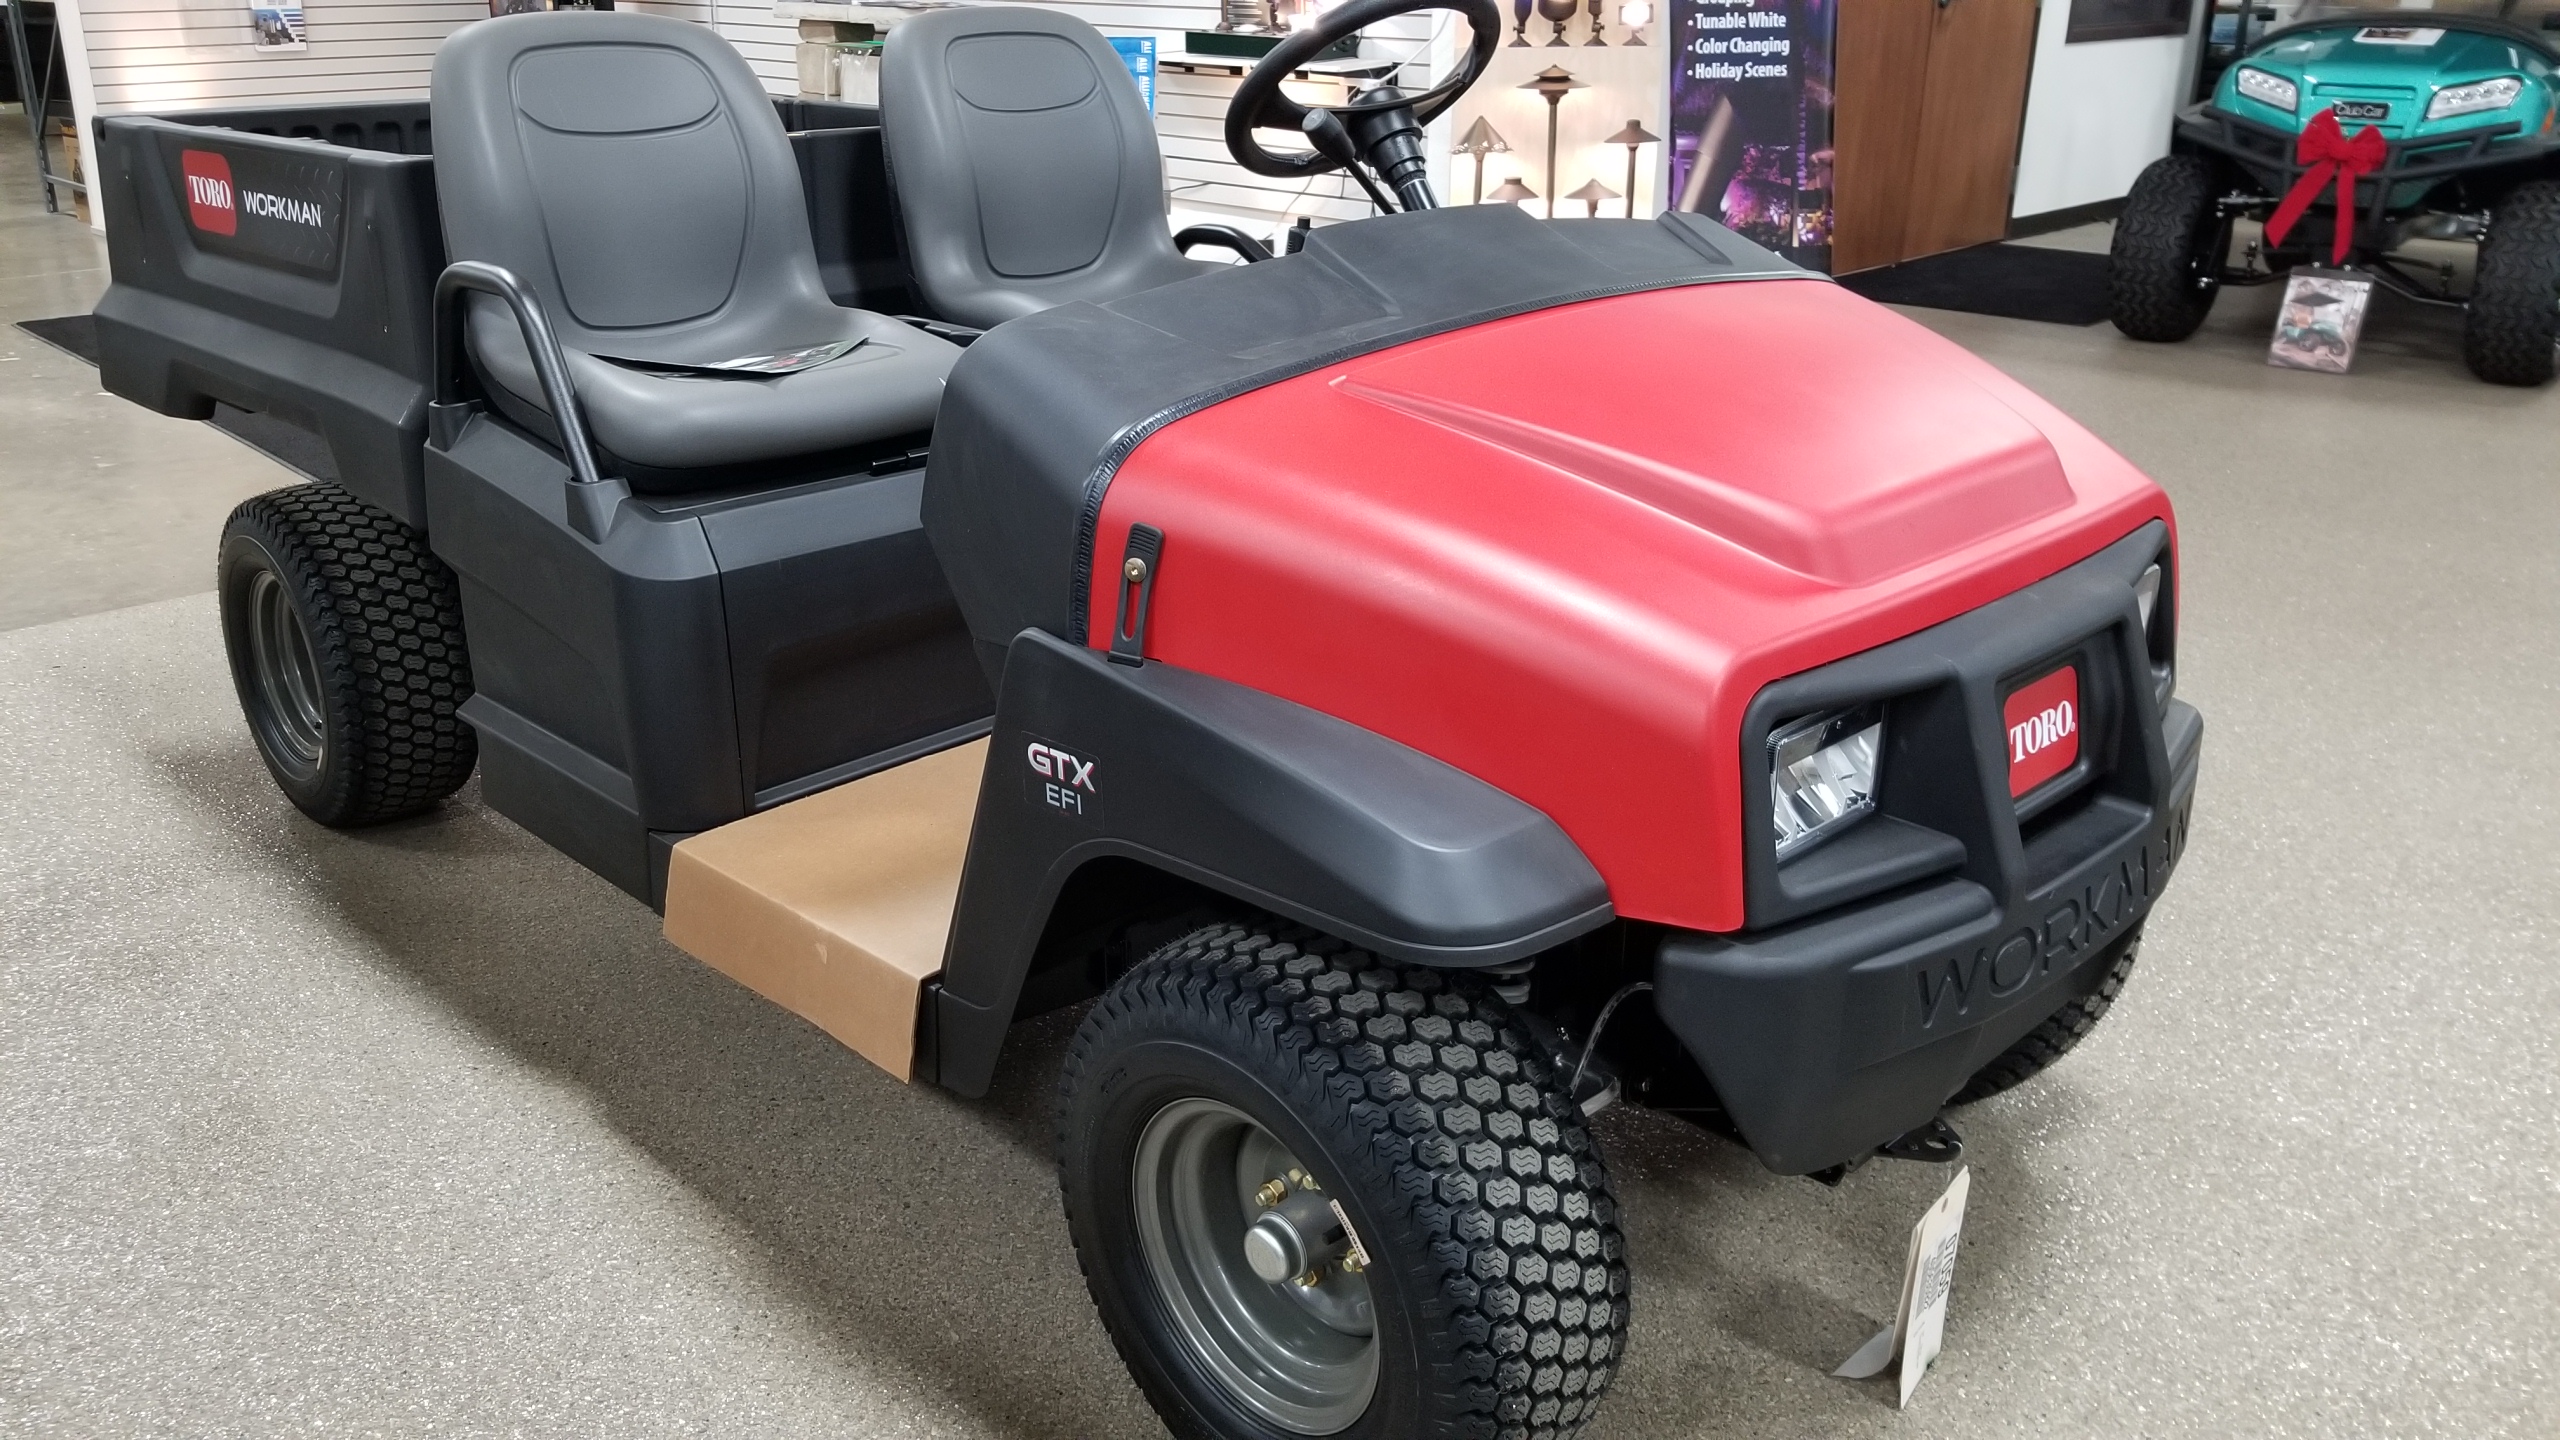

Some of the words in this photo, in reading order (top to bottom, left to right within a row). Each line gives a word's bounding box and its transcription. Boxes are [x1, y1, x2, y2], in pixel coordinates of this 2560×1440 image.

[1695, 12, 1746, 29] Tunable
[1748, 11, 1786, 28] White
[1695, 38, 1728, 54] Color
[1729, 36, 1790, 56] Changing
[1695, 62, 1743, 81] Holiday
[1744, 62, 1787, 77] Scenes
[188, 175, 231, 210] TORO
[243, 190, 322, 228] WORKMAN
[2010, 700, 2073, 763] TORO
[1027, 742, 1095, 793] GTX
[1045, 782, 1082, 815] EFI
